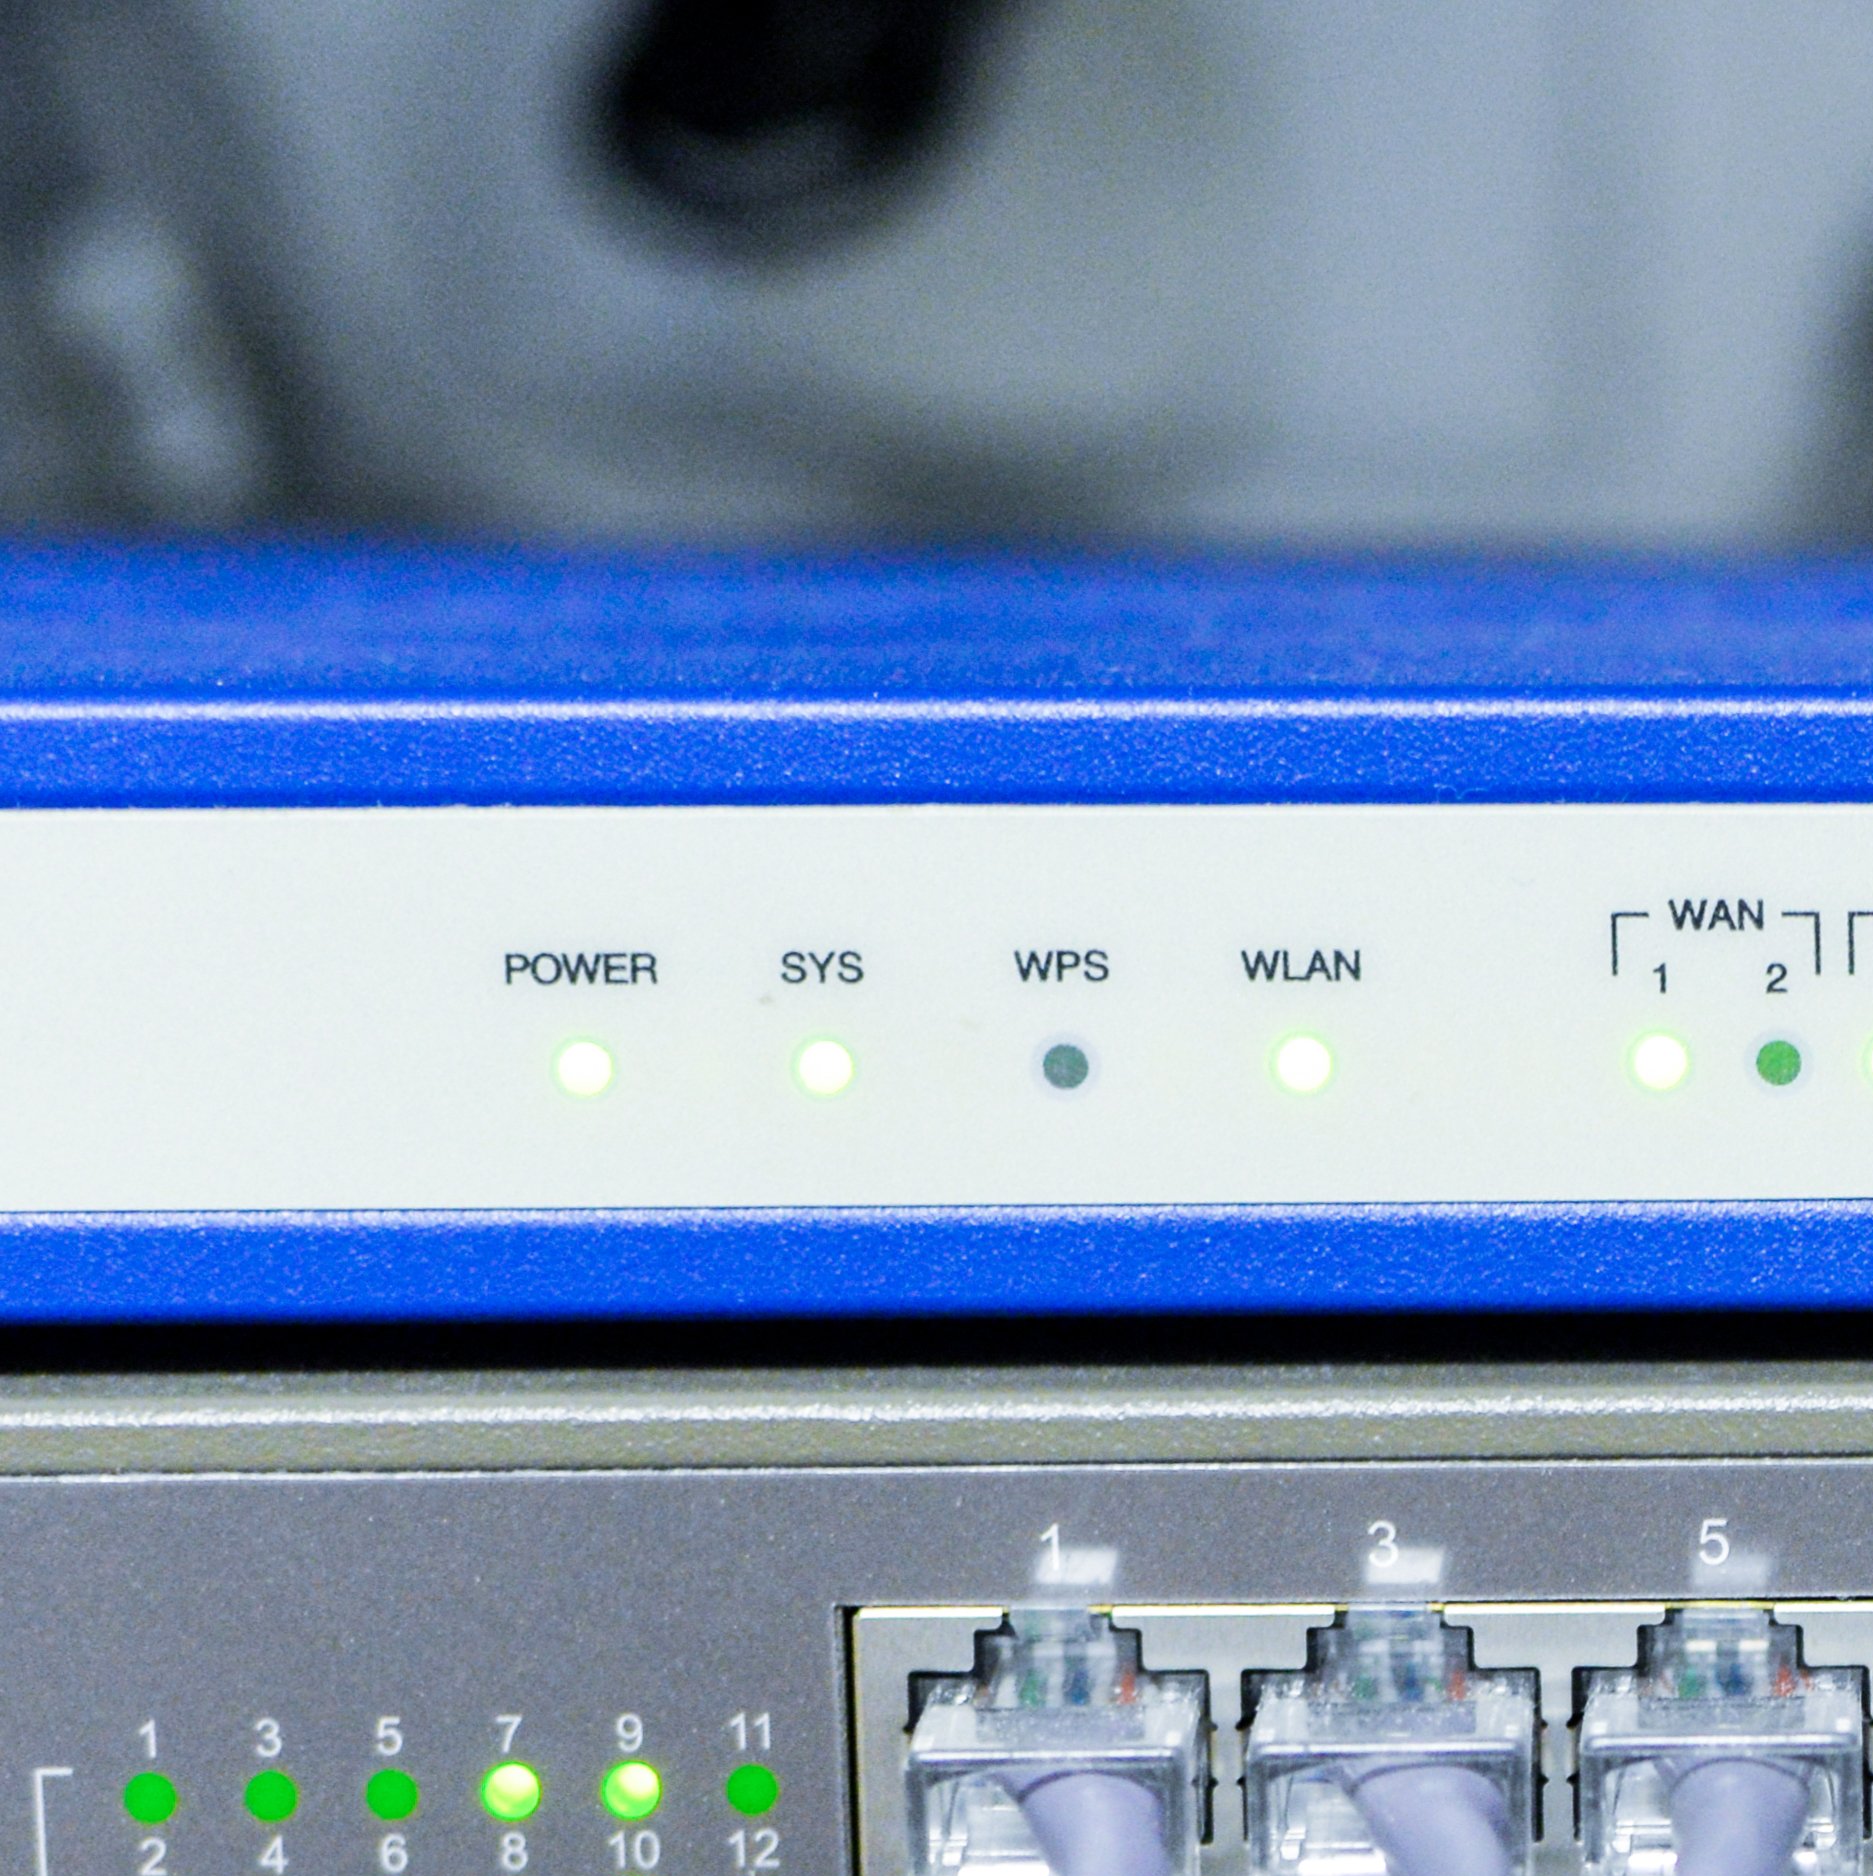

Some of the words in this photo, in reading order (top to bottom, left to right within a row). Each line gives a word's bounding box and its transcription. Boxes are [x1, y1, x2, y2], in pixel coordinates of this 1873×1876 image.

[1668, 899, 1764, 931] WAN
[504, 952, 658, 985] POWER
[781, 950, 865, 985] SYS
[1014, 949, 1110, 982] WPS
[1240, 949, 1361, 982] WLAN
[1653, 963, 1667, 994] 1
[1766, 962, 1788, 994] 2
[1038, 1523, 1062, 1571] 1
[1367, 1520, 1400, 1567] 3
[1698, 1517, 1732, 1564] 5
[138, 1719, 157, 1759] 1
[254, 1717, 283, 1758] 3
[375, 1715, 403, 1756] 5
[495, 1714, 522, 1754] 7
[615, 1712, 644, 1754] 9
[728, 1711, 771, 1751] 11
[259, 1834, 288, 1875] 4
[379, 1833, 408, 1874] 6
[500, 1831, 529, 1872] 8
[608, 1829, 661, 1870] 10
[728, 1827, 780, 1868] 12
